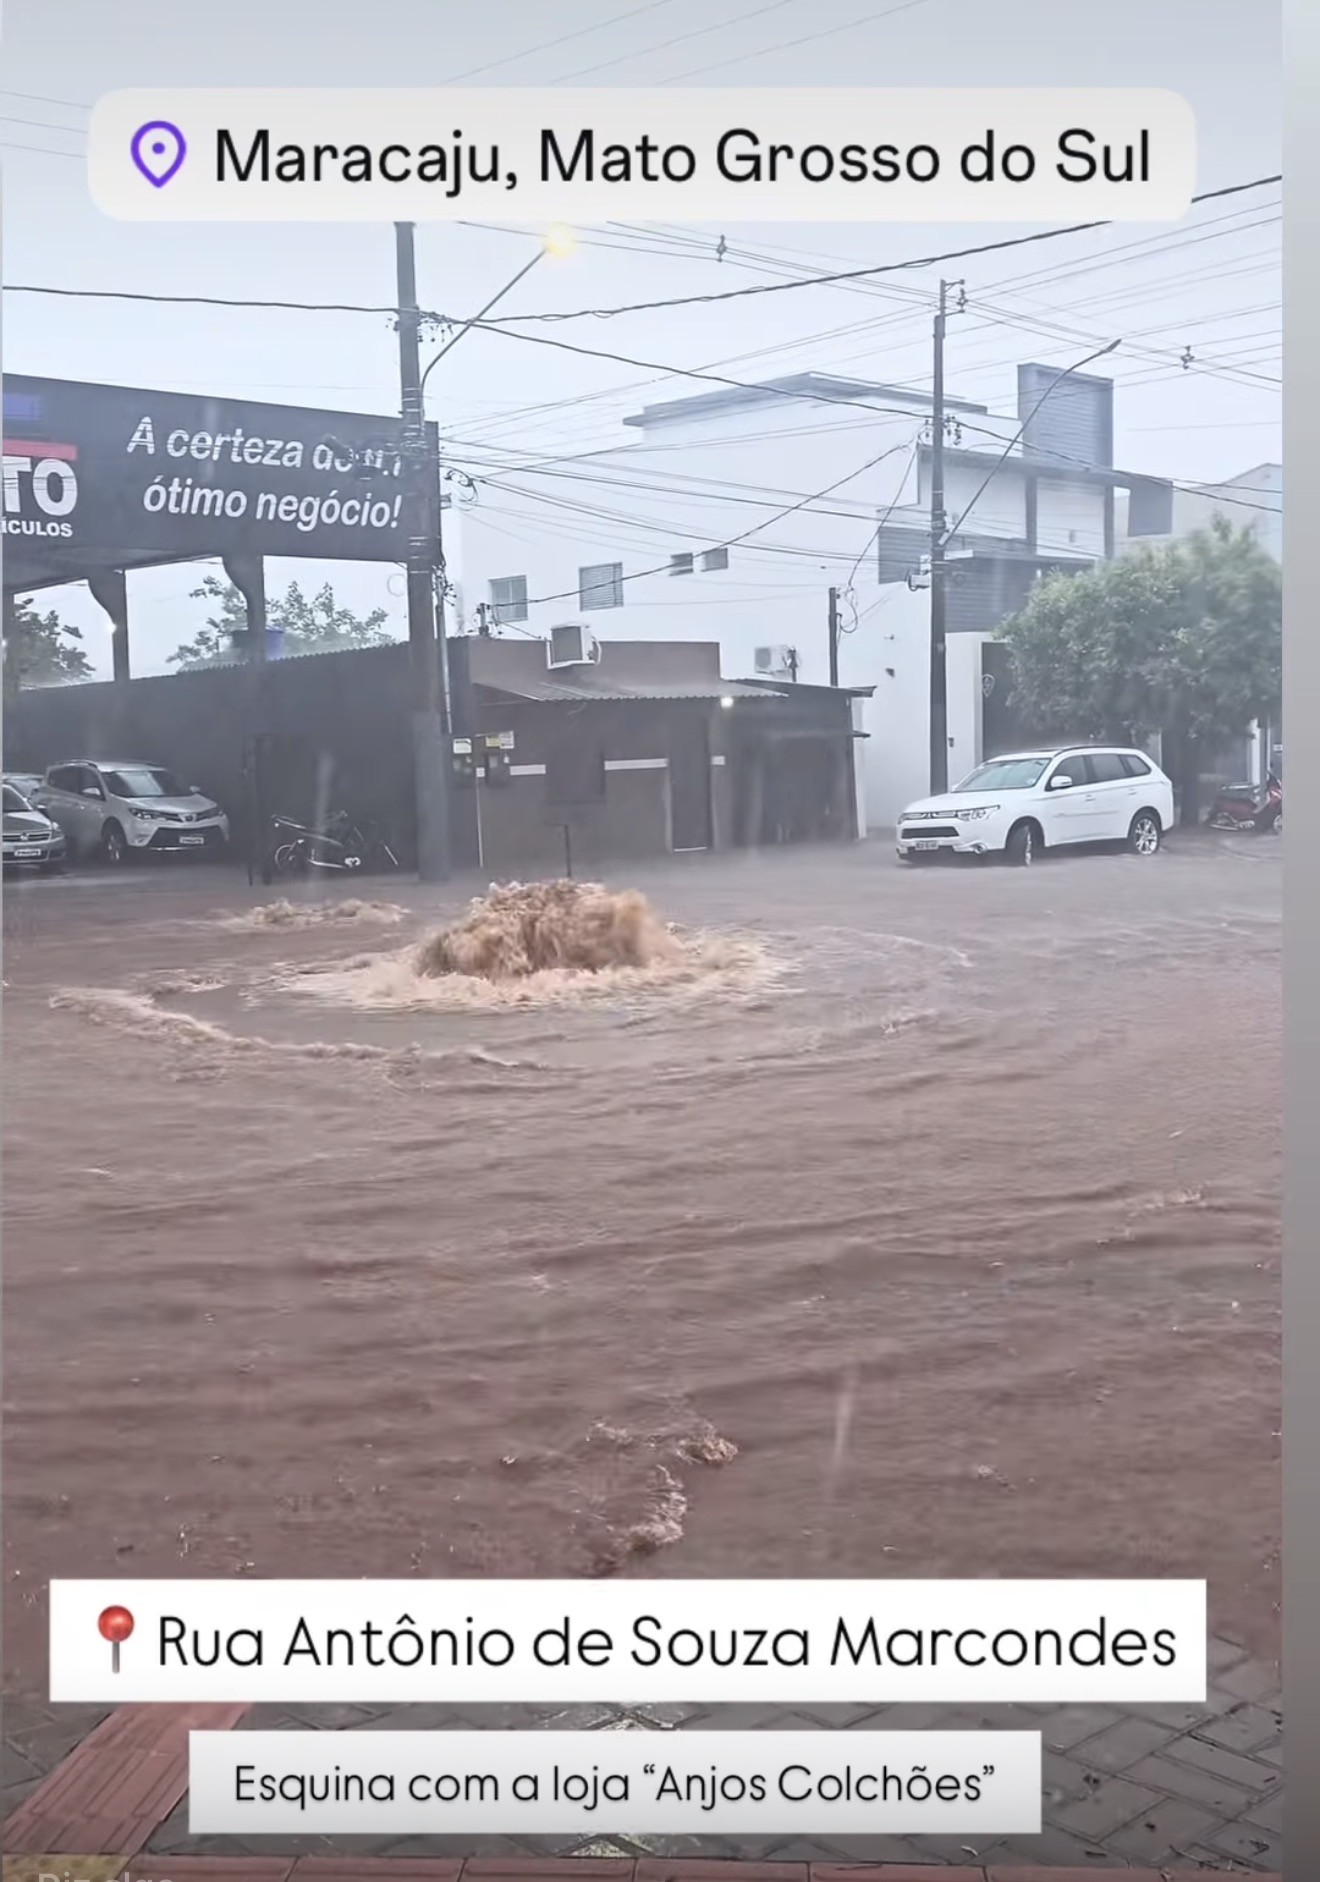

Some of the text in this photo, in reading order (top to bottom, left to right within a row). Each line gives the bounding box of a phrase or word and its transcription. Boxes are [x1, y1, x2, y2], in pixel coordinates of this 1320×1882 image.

[126, 416, 155, 455] A
[166, 428, 302, 467] certeza
[143, 475, 402, 532] ótimo negócio!
